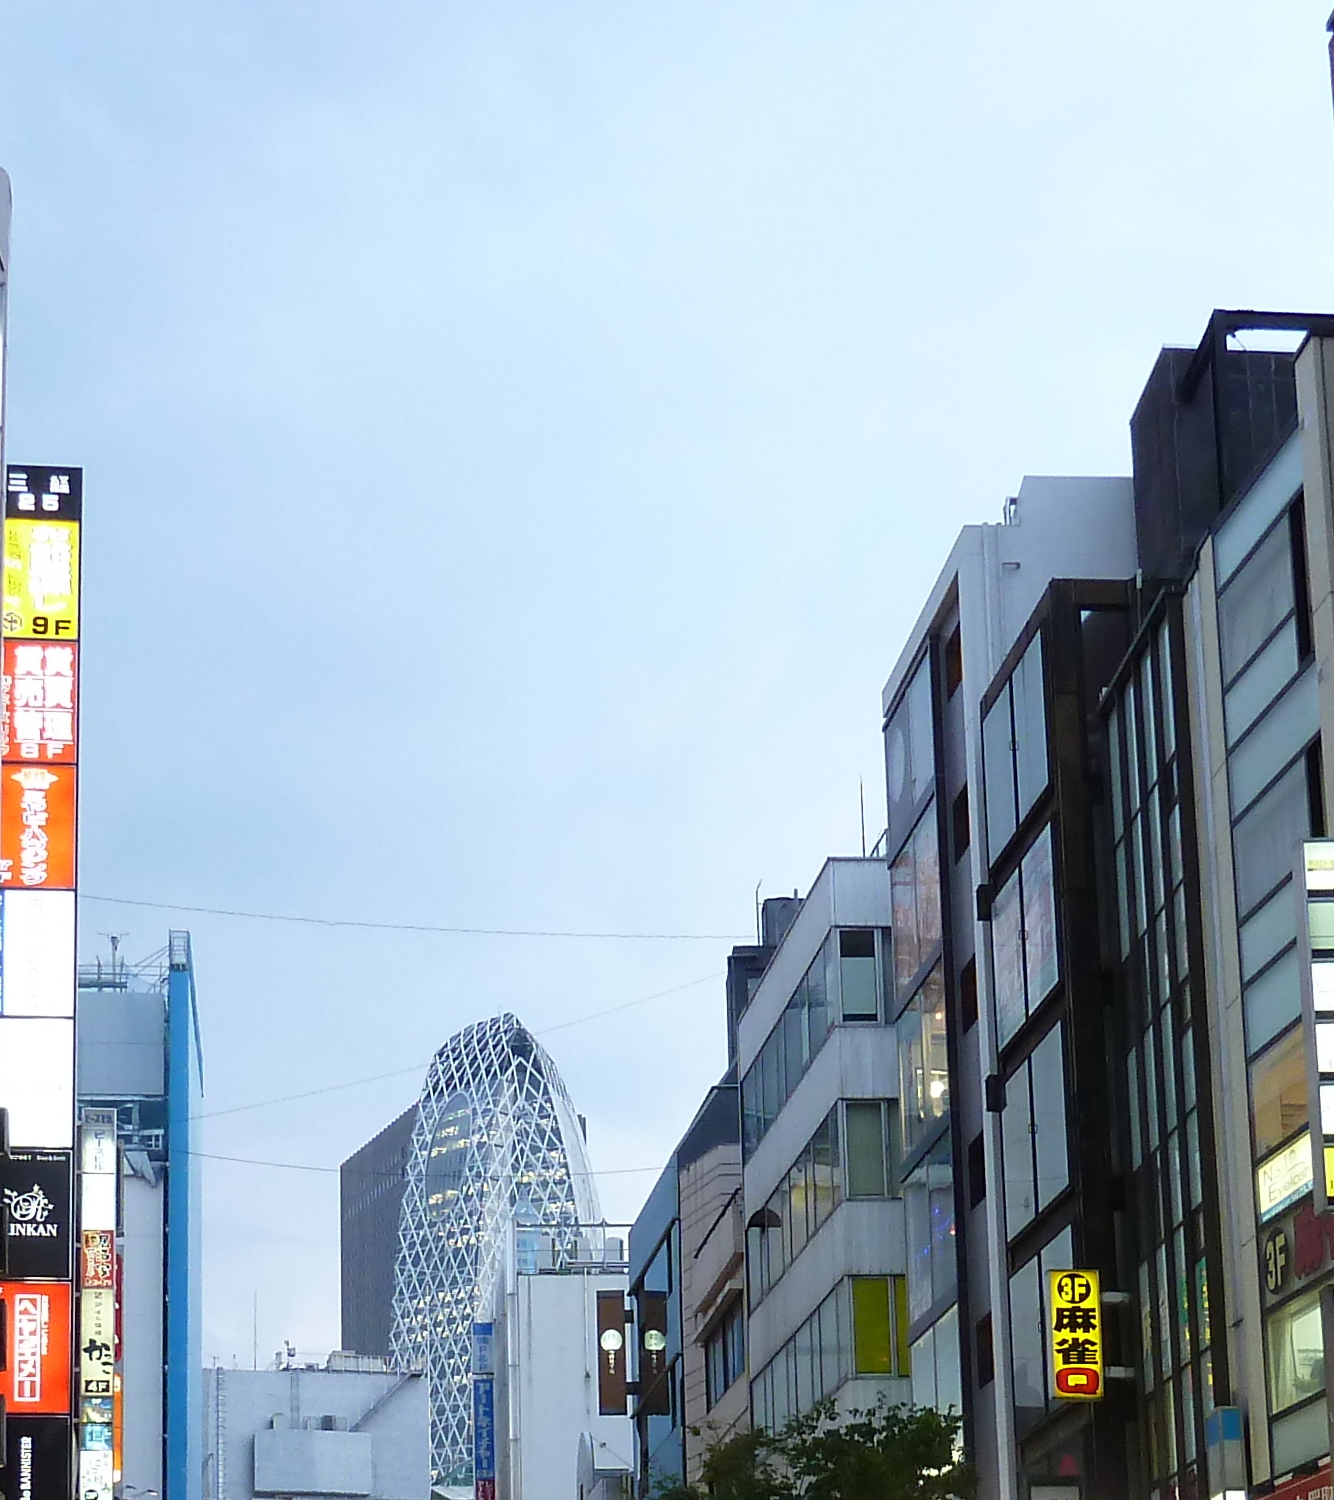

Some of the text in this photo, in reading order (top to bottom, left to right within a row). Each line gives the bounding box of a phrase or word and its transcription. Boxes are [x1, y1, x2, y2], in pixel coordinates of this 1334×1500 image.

[32, 616, 72, 636] 9F
[1266, 1233, 1286, 1290] 3F
[1060, 1277, 1088, 1303] 3F
[1053, 1305, 1099, 1365] 麻雀
[86, 1381, 108, 1392] 4F
